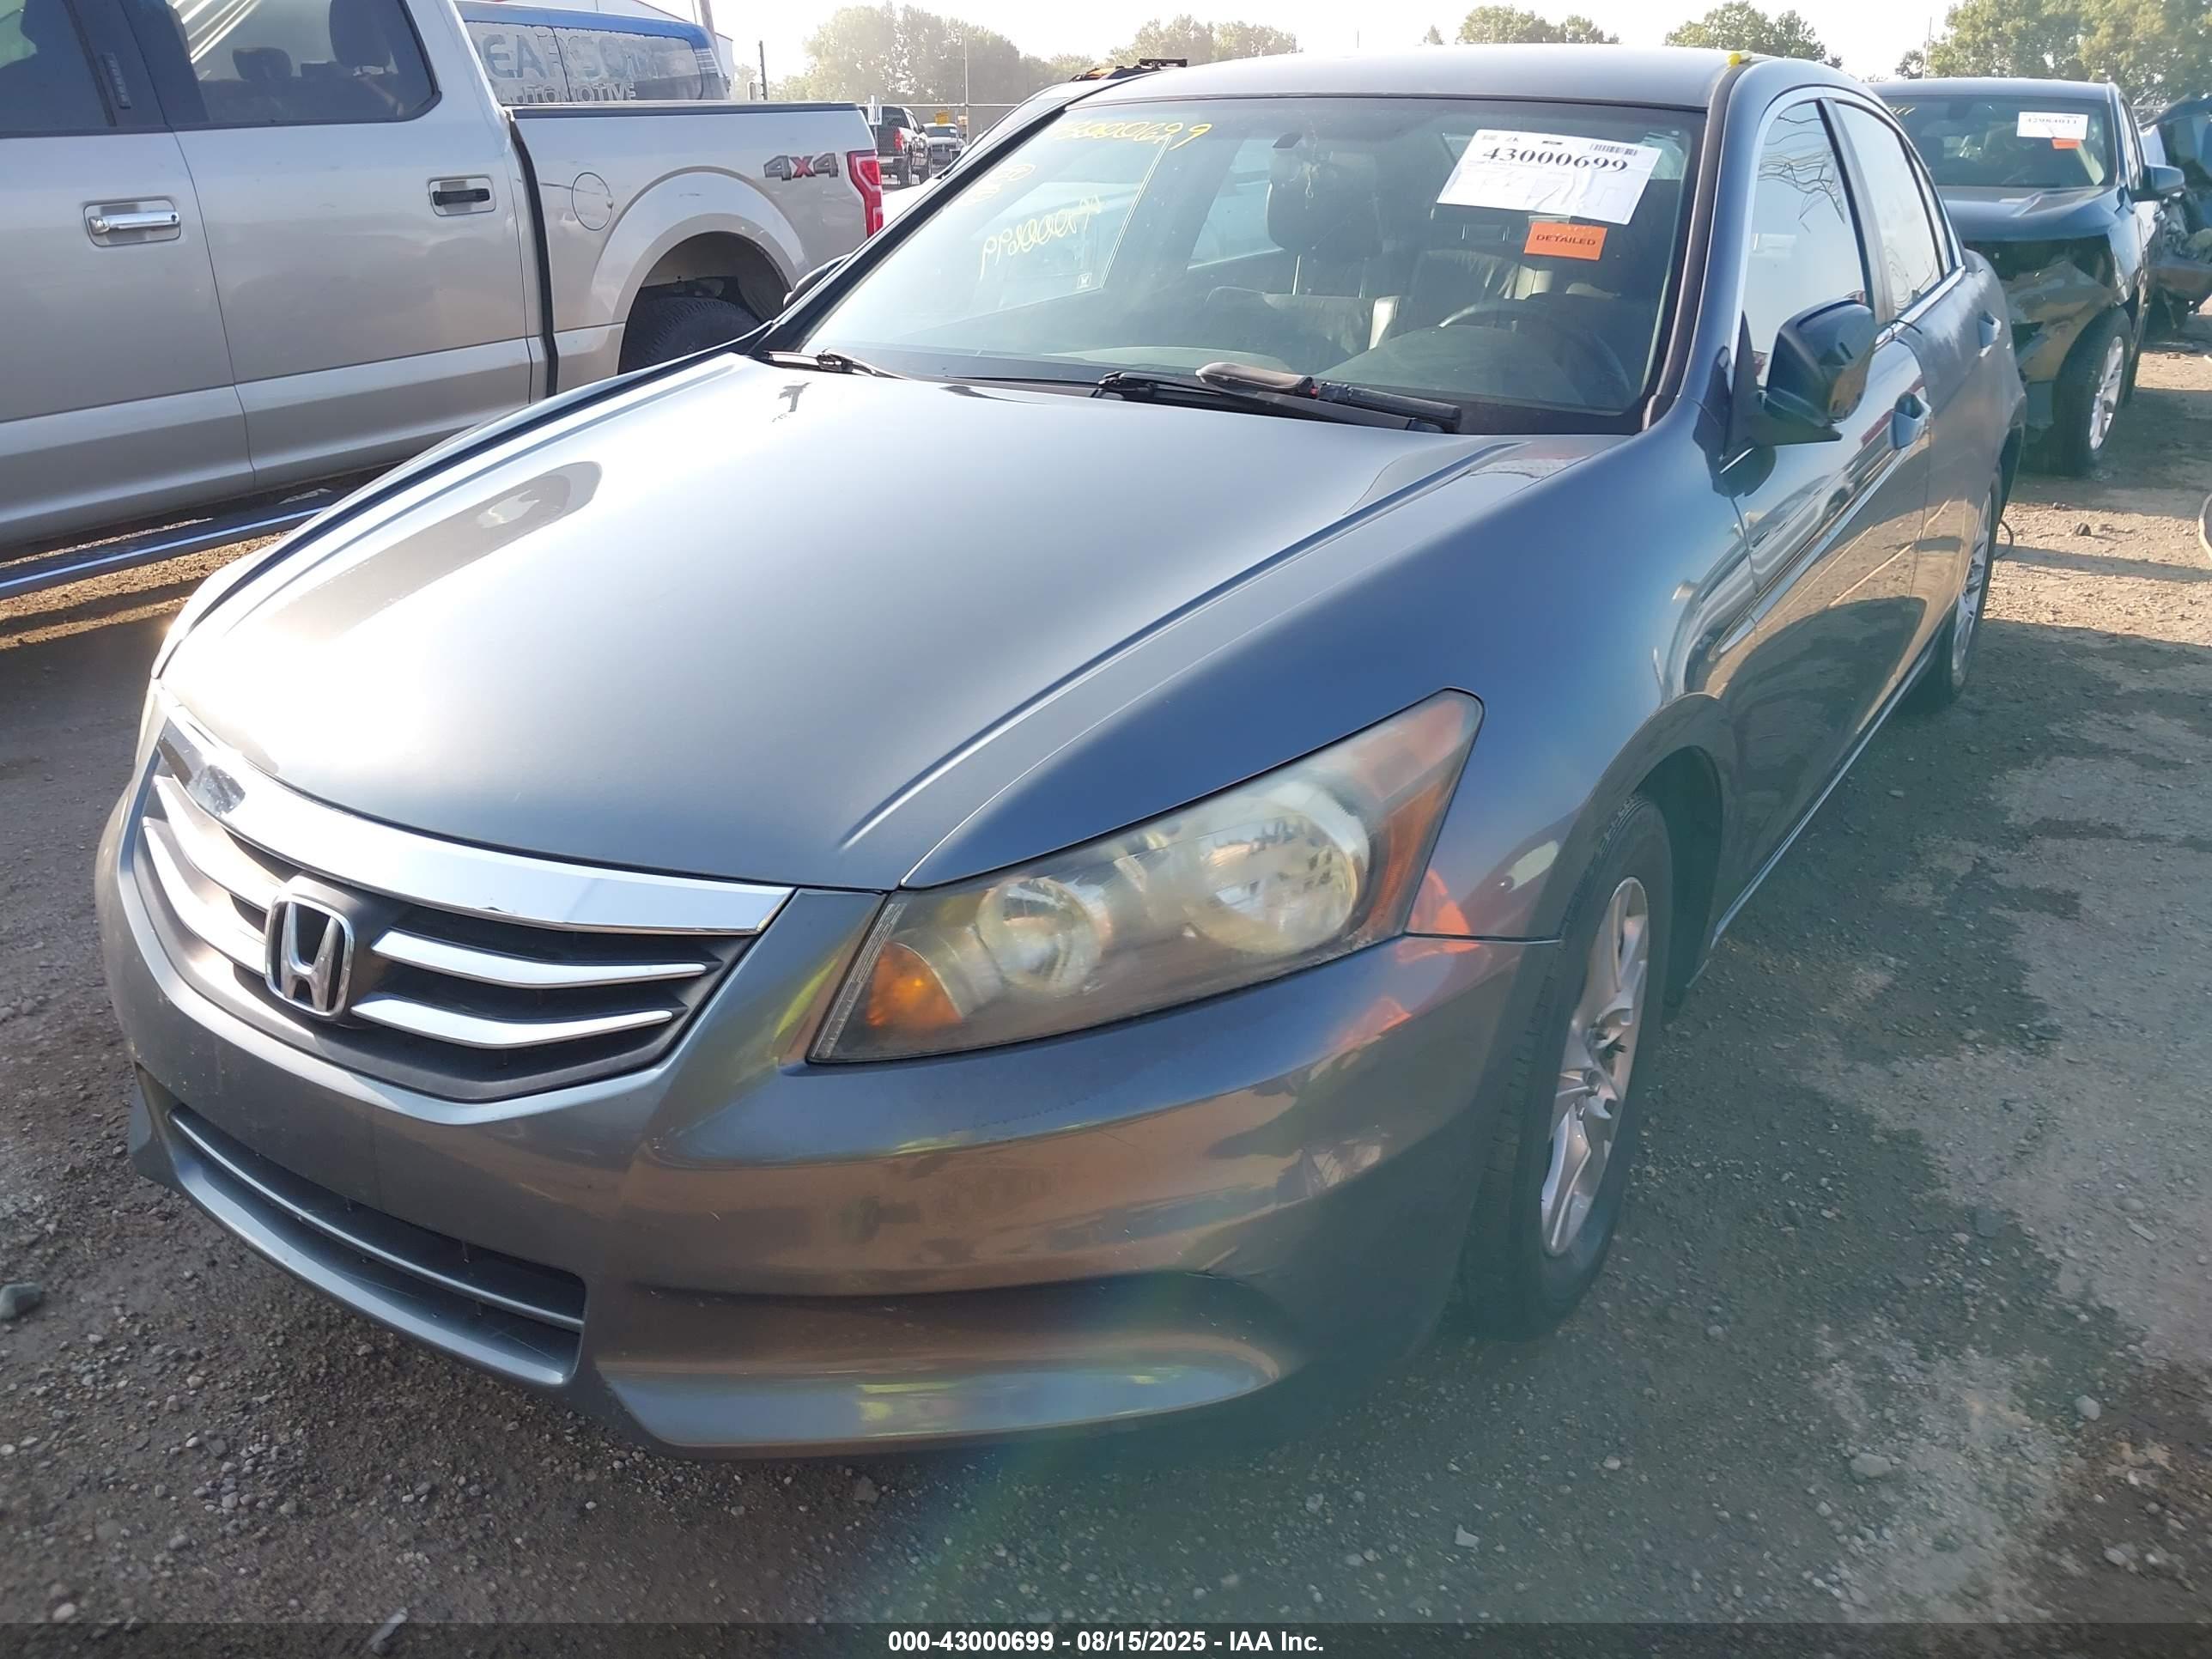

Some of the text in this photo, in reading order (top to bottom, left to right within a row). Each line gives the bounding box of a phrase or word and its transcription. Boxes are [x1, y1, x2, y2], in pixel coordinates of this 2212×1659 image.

[474, 33, 658, 79] EARSON
[498, 83, 636, 104] AUTOMOTIVE
[1483, 148, 1628, 172] 43000699
[1536, 234, 1595, 246] DETAILED
